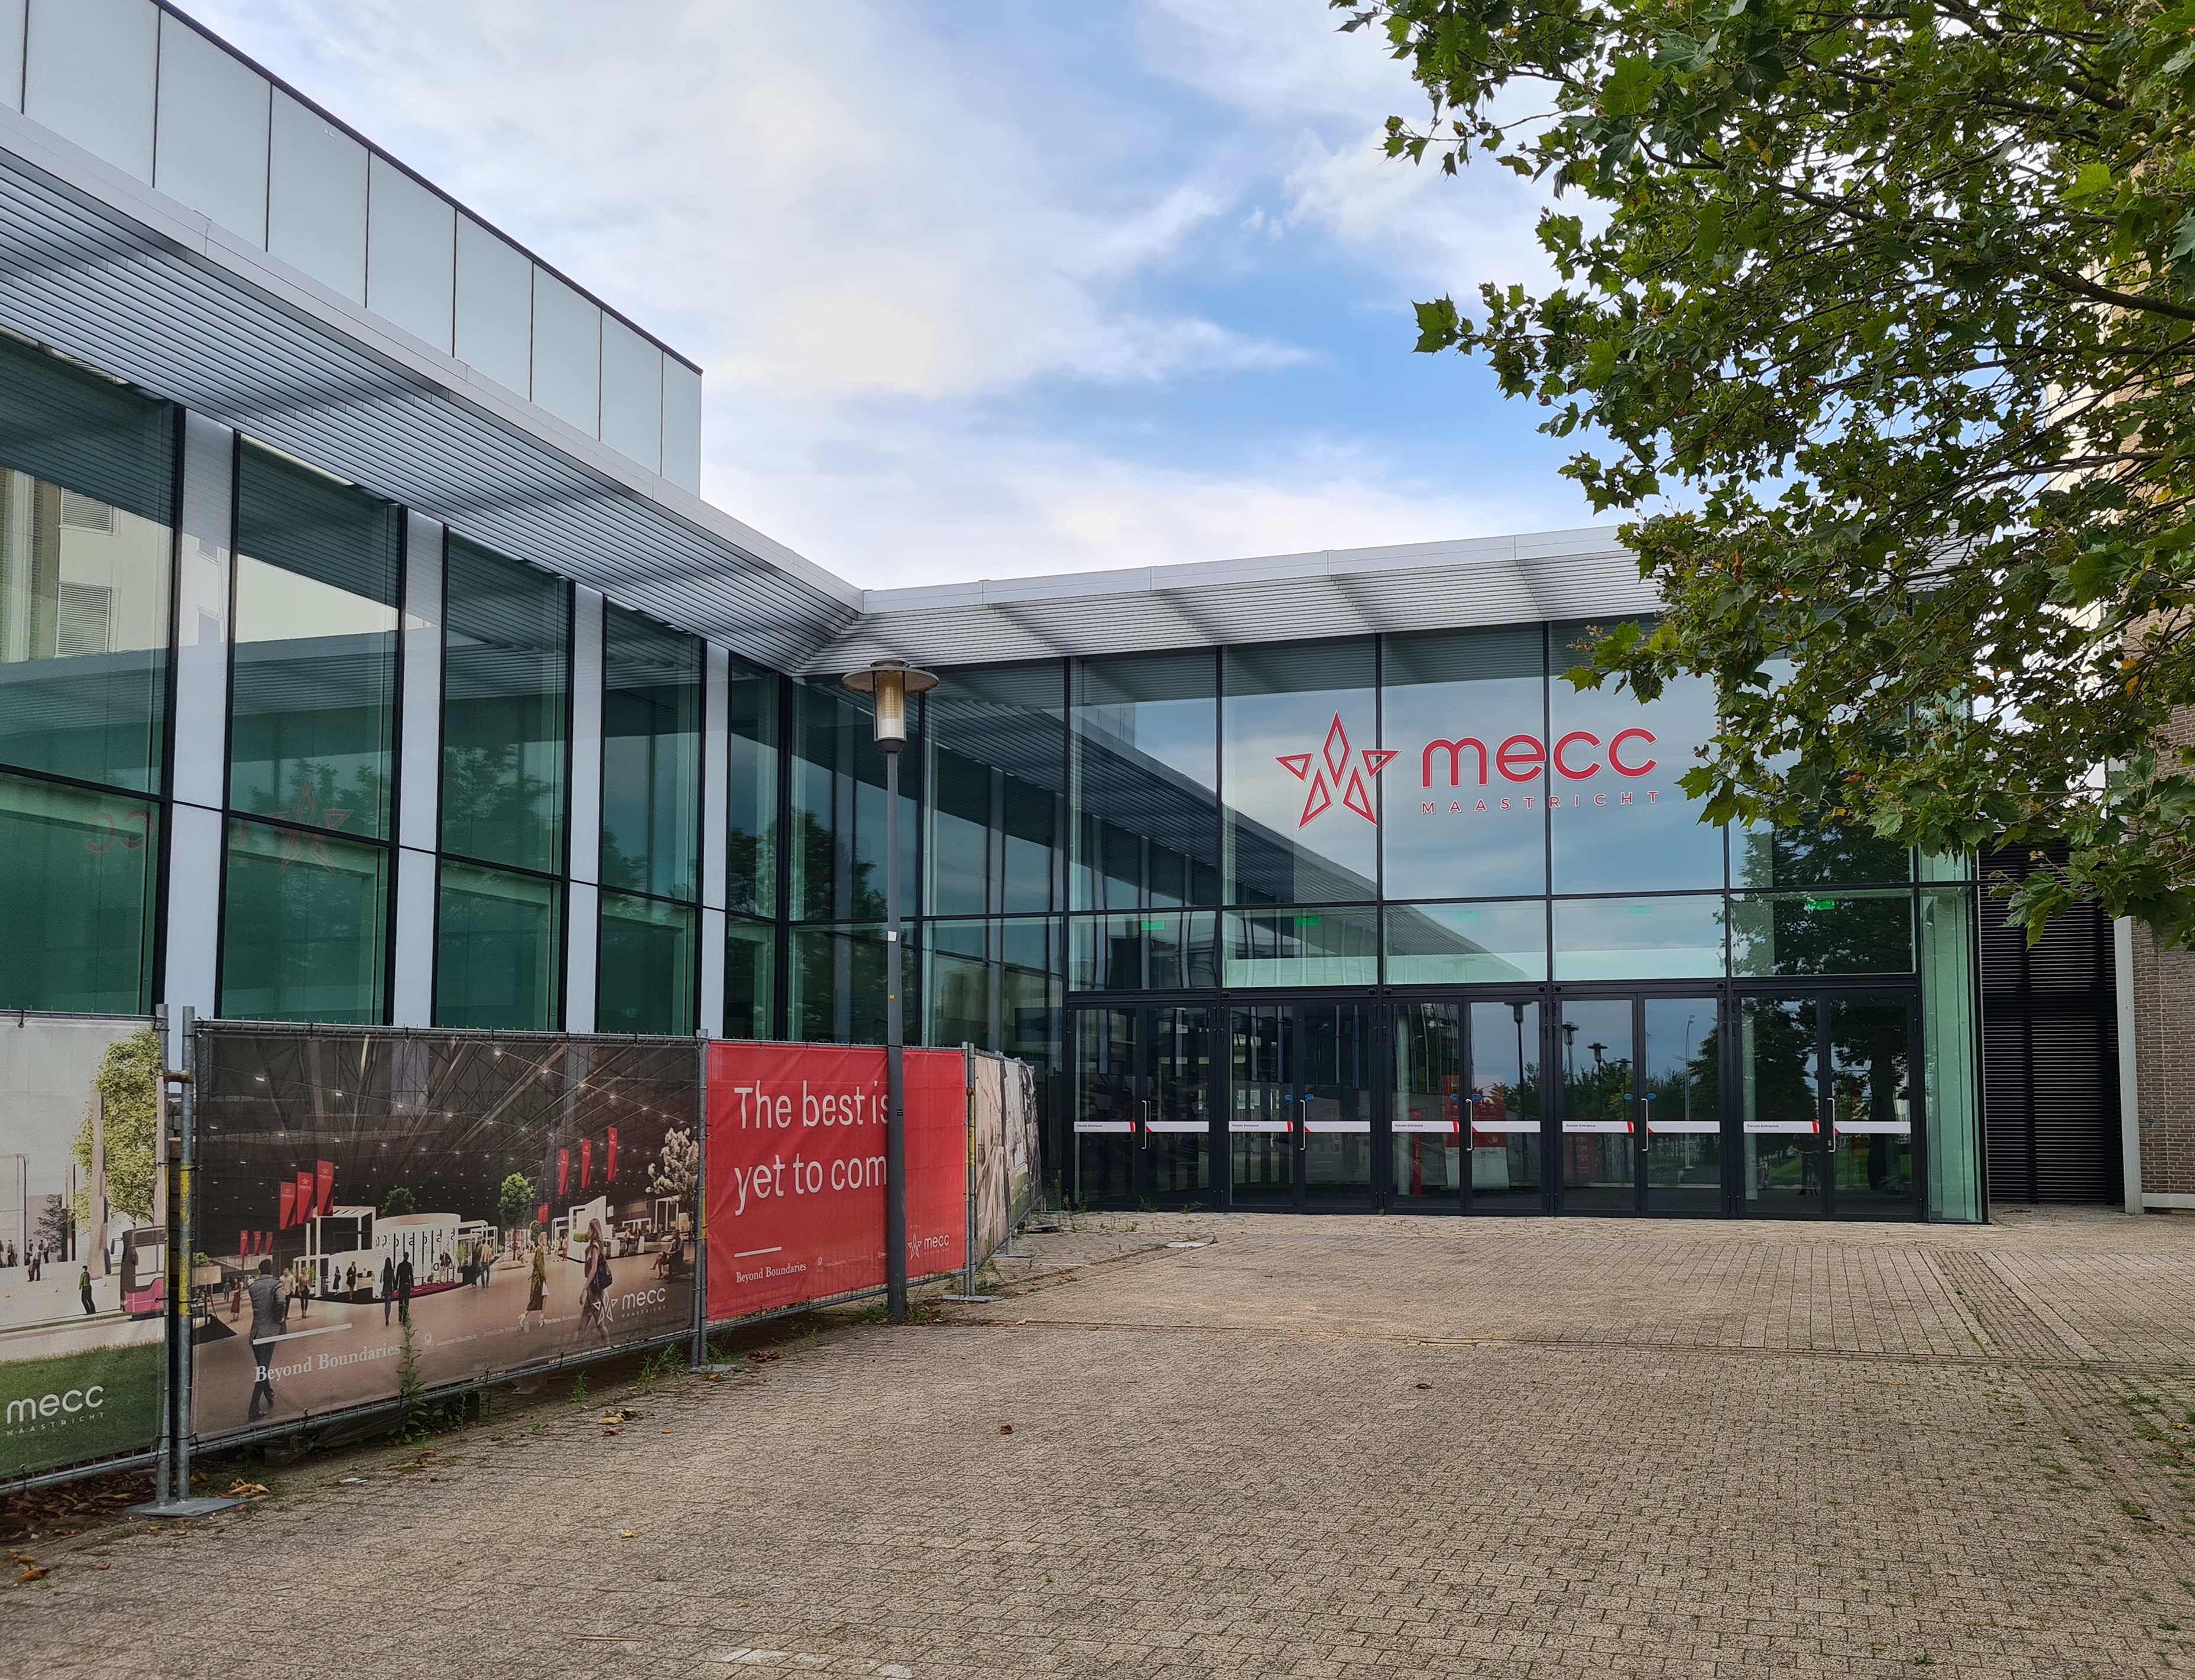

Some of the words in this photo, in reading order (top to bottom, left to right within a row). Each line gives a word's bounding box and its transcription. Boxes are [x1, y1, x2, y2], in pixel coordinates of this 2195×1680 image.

[1421, 727, 1658, 788] mecc
[1421, 790, 1659, 814] MAASTRICHT
[734, 1080, 792, 1129] The
[803, 1080, 865, 1127] best
[734, 1154, 786, 1216] yet
[793, 1153, 823, 1195] to
[831, 1156, 887, 1191] com
[924, 1234, 949, 1250] mecc
[735, 1267, 764, 1283] Beyond
[766, 1261, 807, 1278] Boundaries
[621, 1287, 666, 1311] mecc
[254, 1357, 313, 1383] Beyond
[317, 1344, 402, 1370] Boundaries
[7, 1386, 104, 1424] mecc
[7, 1412, 104, 1436] MAASTRICHT
